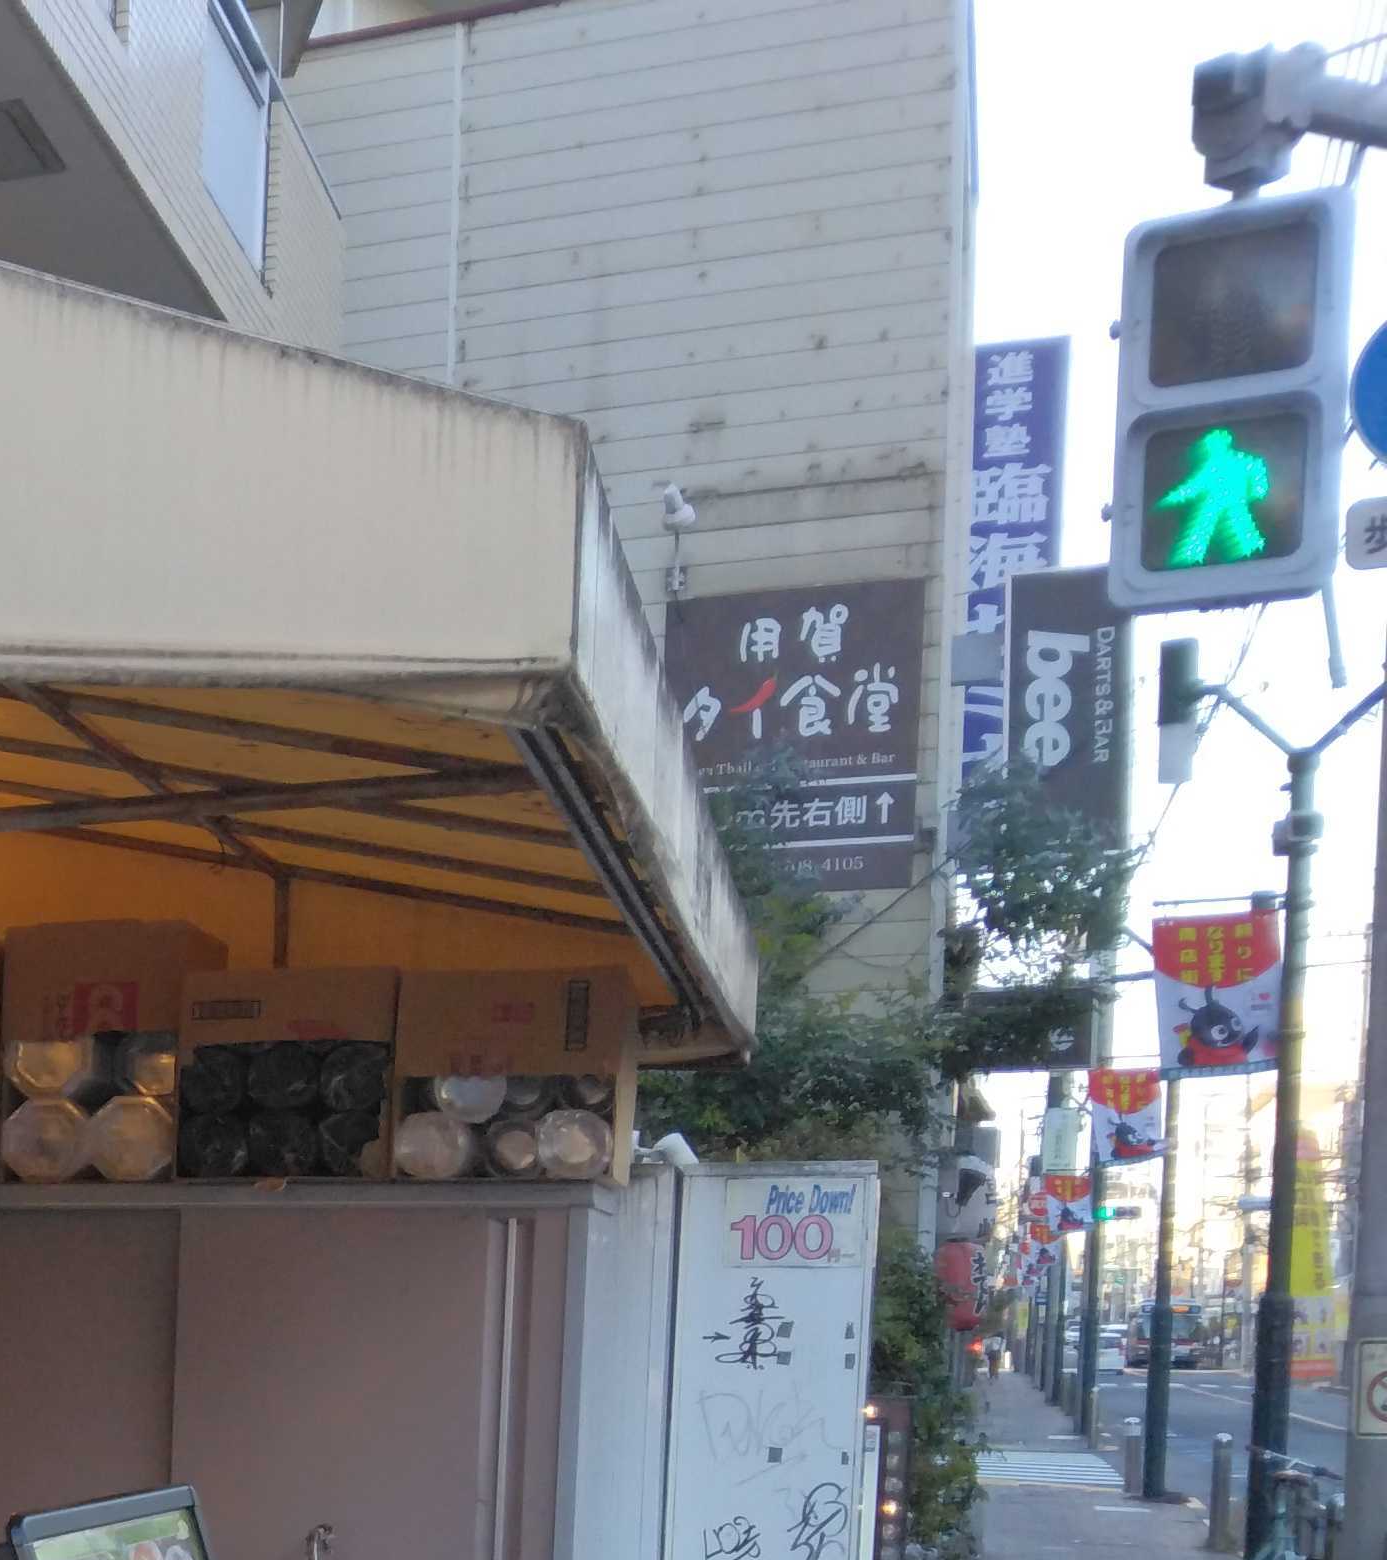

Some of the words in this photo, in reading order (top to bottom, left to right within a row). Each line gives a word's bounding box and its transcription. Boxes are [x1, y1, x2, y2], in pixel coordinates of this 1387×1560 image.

[984, 351, 1034, 460] 進学塾
[739, 603, 850, 663] 用賀
[682, 662, 900, 742] タイ食堂
[1023, 629, 1091, 768] bee
[764, 1184, 804, 1215] Price
[808, 1183, 858, 1215] Down!
[730, 1214, 834, 1261] 100
